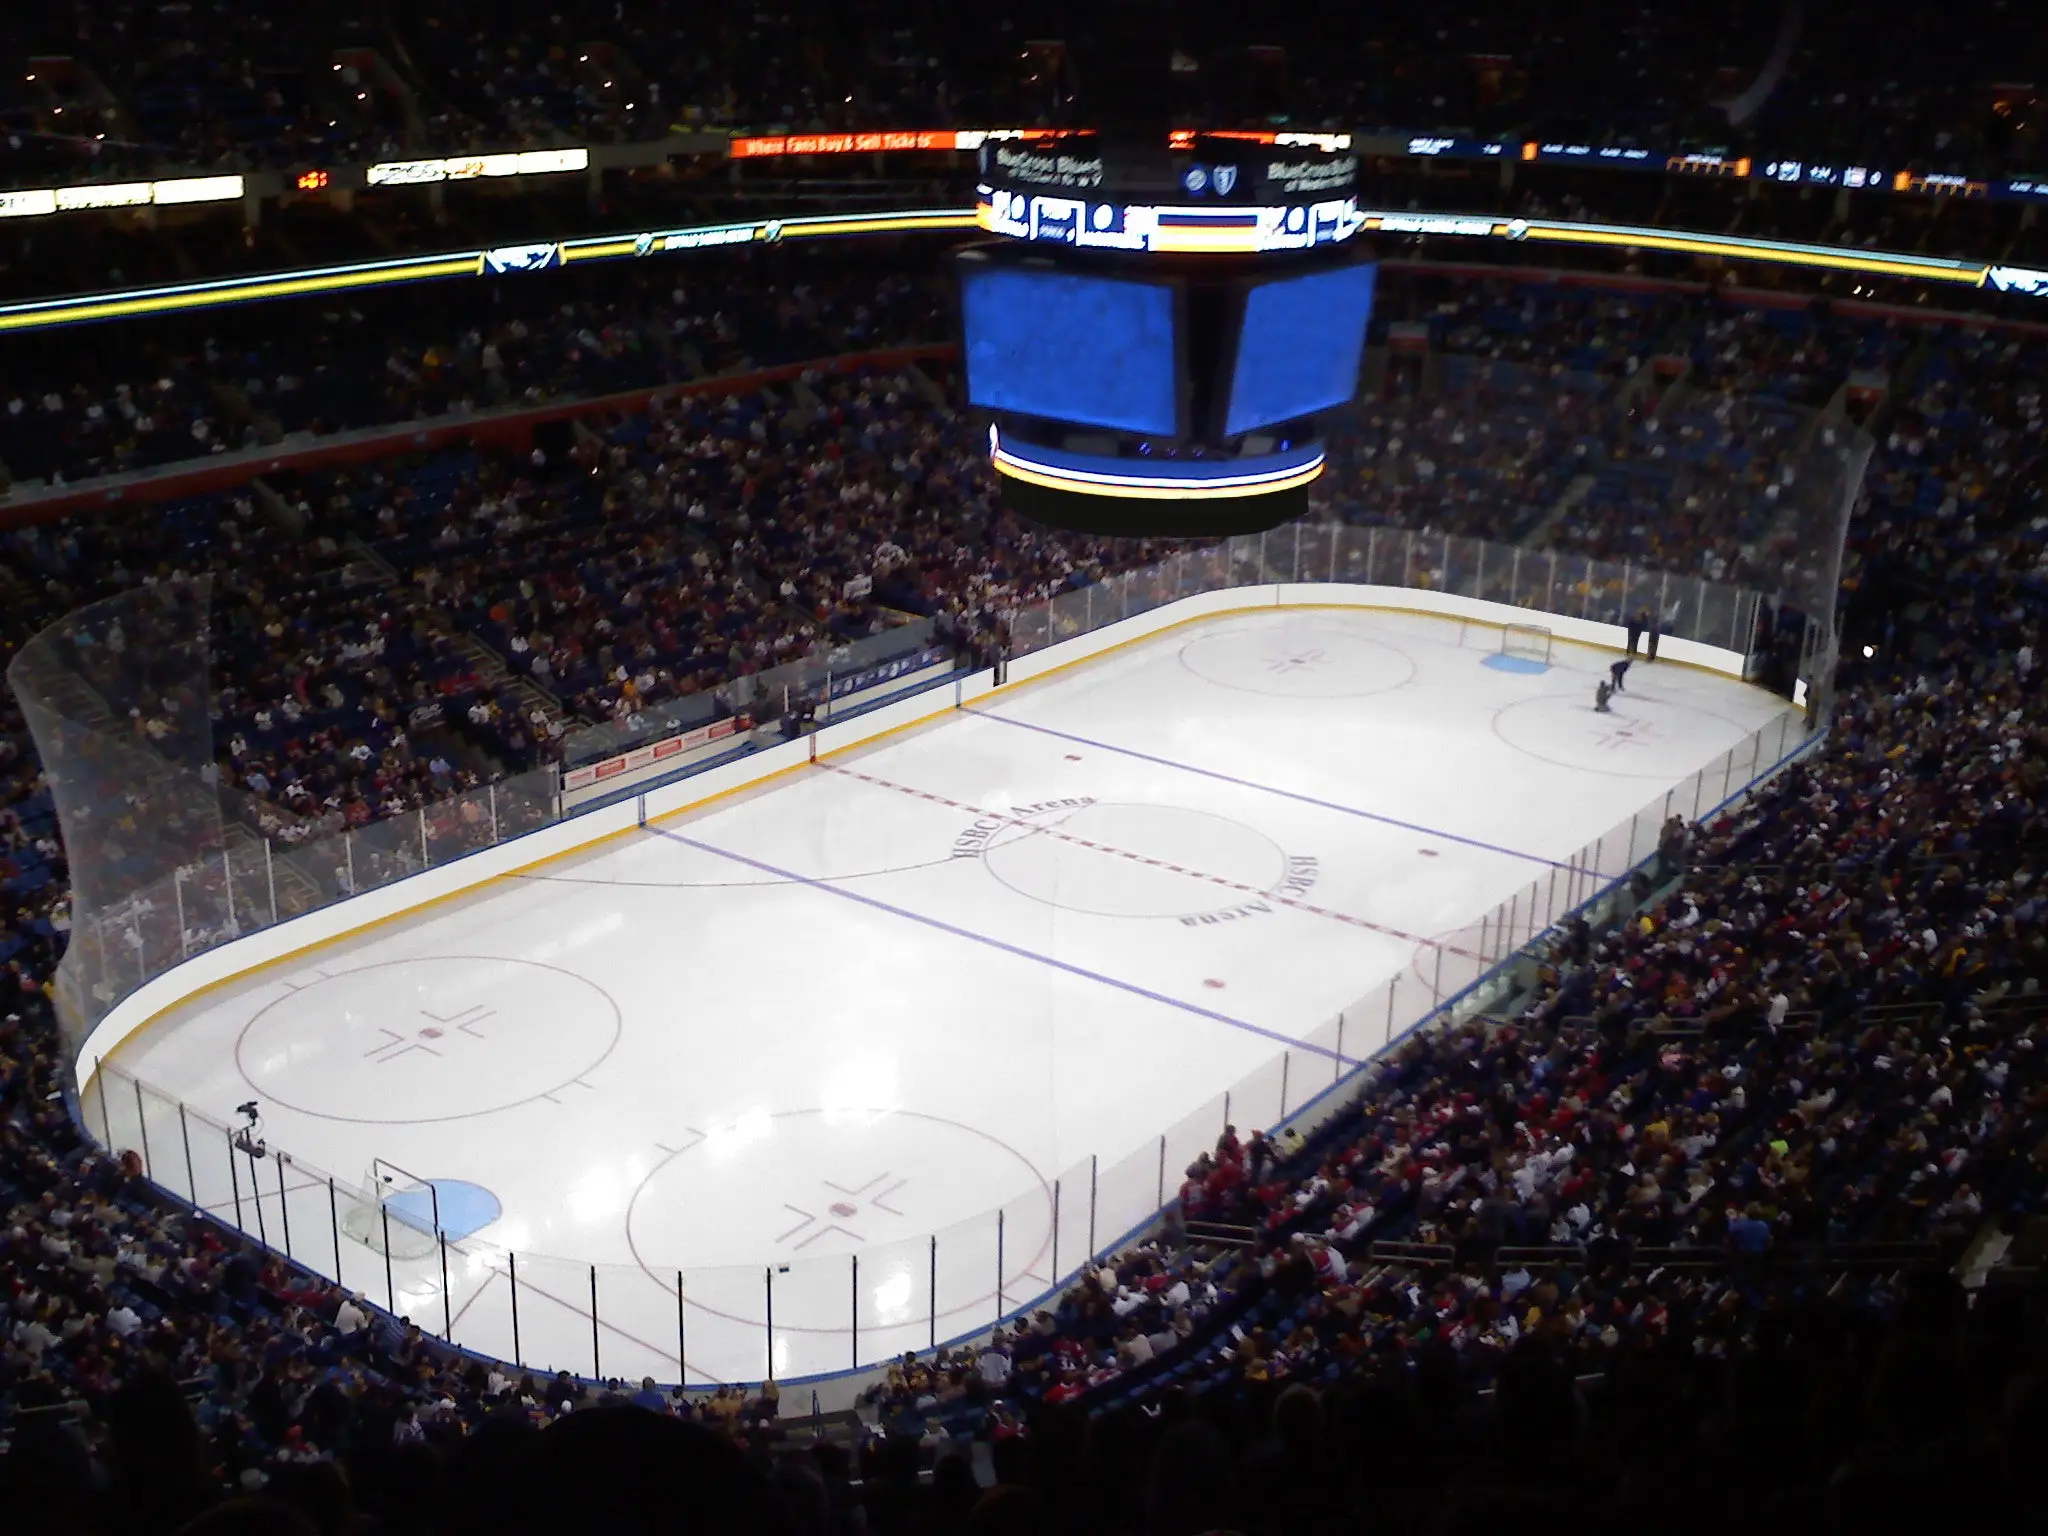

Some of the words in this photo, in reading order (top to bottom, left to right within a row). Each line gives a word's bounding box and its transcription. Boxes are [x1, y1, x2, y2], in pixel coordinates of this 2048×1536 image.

[786, 137, 817, 152] Fans
[818, 136, 843, 152] Buy
[854, 133, 881, 150] Sell
[953, 819, 1000, 858] HSBC
[1010, 796, 1095, 816] Arena
[1281, 856, 1319, 897] HSBC
[1179, 900, 1273, 927] Arena
